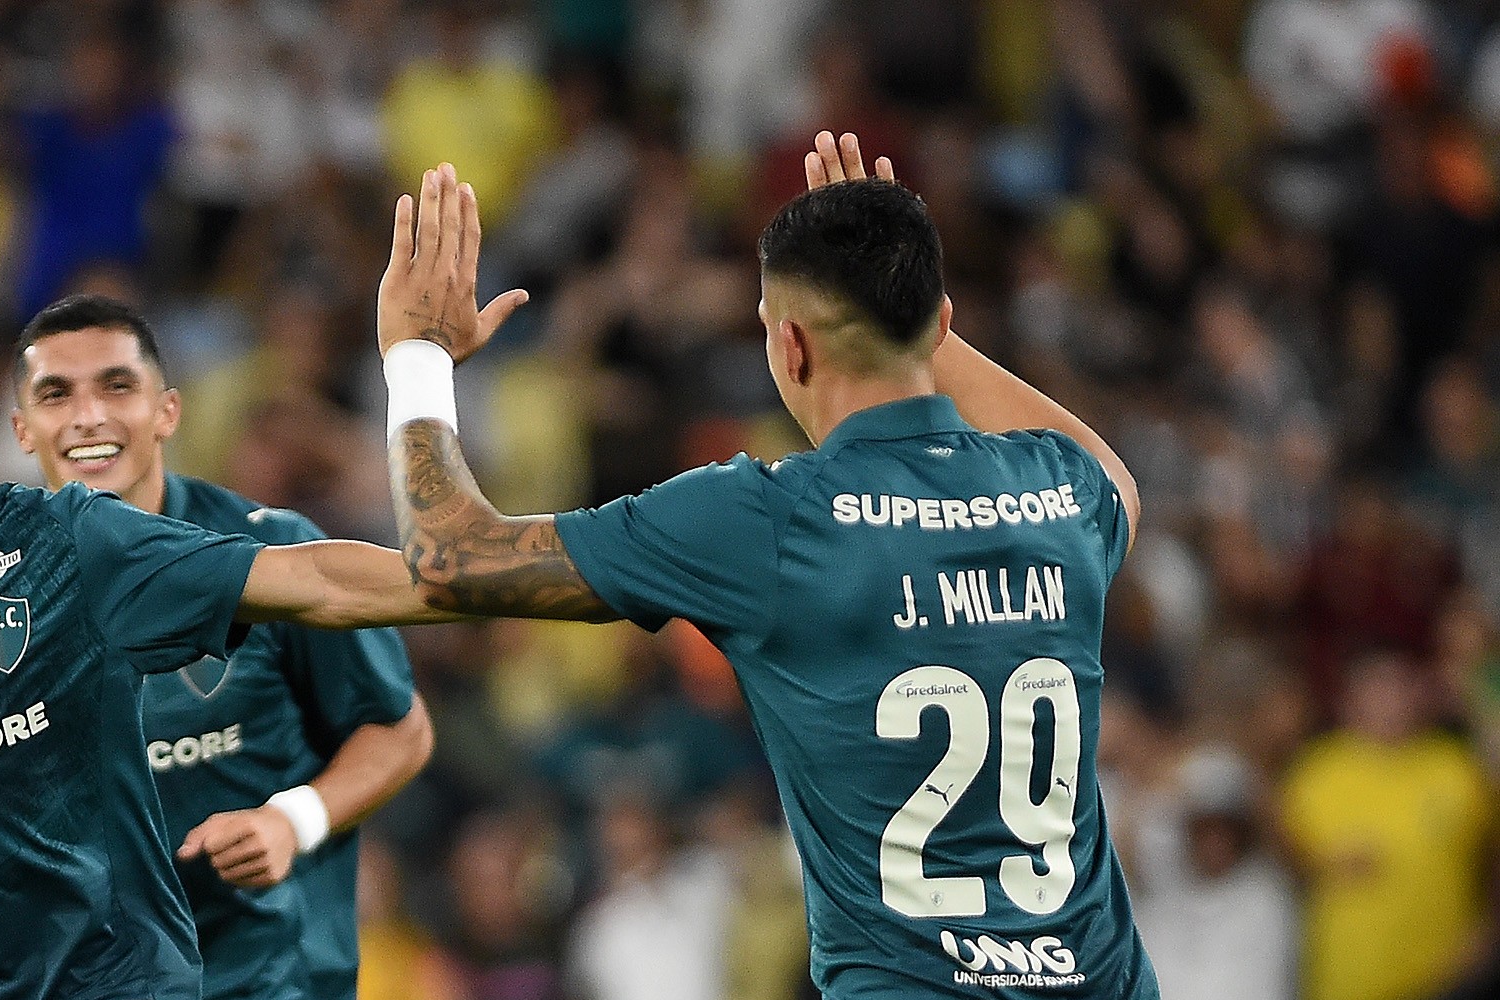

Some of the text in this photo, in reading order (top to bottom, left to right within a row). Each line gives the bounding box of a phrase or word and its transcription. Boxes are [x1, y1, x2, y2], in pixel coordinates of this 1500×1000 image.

[832, 483, 1081, 529] SUPERSCORE
[893, 565, 1066, 629] J. MILLAN
[906, 683, 968, 698] predialnet
[1022, 677, 1066, 691] predialnet
[876, 657, 1081, 918] 29
[954, 970, 1044, 987] UNIVERSIDADE
